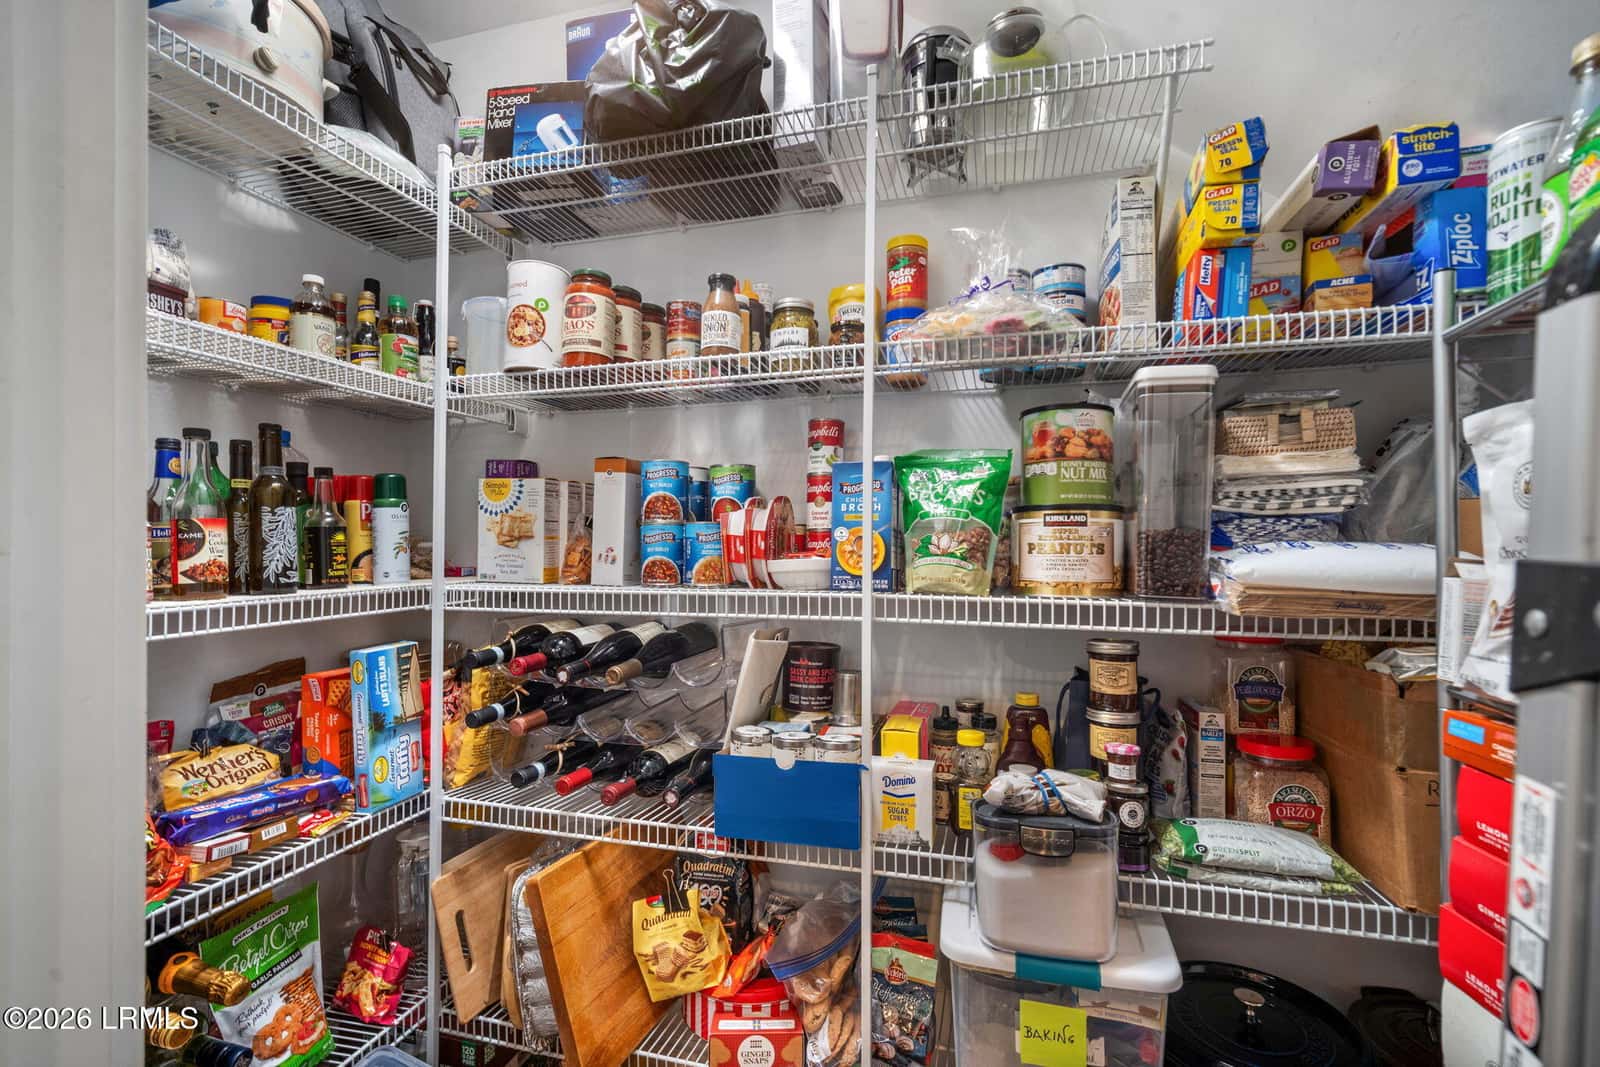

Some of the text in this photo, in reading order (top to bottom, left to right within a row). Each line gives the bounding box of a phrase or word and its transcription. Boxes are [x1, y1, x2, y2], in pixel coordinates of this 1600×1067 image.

[568, 26, 591, 41] BRAUN
[489, 94, 531, 109] 5-Speed
[488, 106, 516, 120] Hand
[487, 118, 514, 131] Mixer
[1209, 125, 1237, 144] GLAD
[1401, 129, 1454, 145] stretch-
[1219, 146, 1240, 156] SEAL
[1413, 141, 1436, 153] tite
[1218, 157, 1232, 168] 70
[1488, 152, 1545, 184] TWATER
[1205, 187, 1233, 200] GLAD
[1491, 182, 1532, 210] RUM
[1224, 215, 1237, 225] 70
[1311, 237, 1340, 251] GLAD
[1451, 212, 1480, 266] Ziploc
[888, 267, 917, 281] Peter
[1201, 256, 1212, 285] Hefty
[150, 292, 184, 317] SHEY'S
[1060, 466, 1107, 480] NUT MIX
[843, 480, 881, 493] PROGSO
[1045, 514, 1087, 523] KIRKLAND
[152, 529, 171, 538] Holl
[699, 533, 721, 543] PROGRE
[1028, 542, 1105, 556] PEANUTS
[395, 734, 411, 792] Taffy
[205, 758, 273, 790] Original
[882, 775, 917, 788] Domino
[887, 806, 910, 815] SUGAR
[1276, 805, 1315, 820] ORZO
[1476, 820, 1509, 841] LEMON
[683, 860, 737, 877] Quadratini
[1477, 903, 1506, 923] GINGE
[1465, 970, 1498, 999] LEMON
[1023, 1024, 1075, 1045] BAKING
[740, 1050, 772, 1060] GINGER
